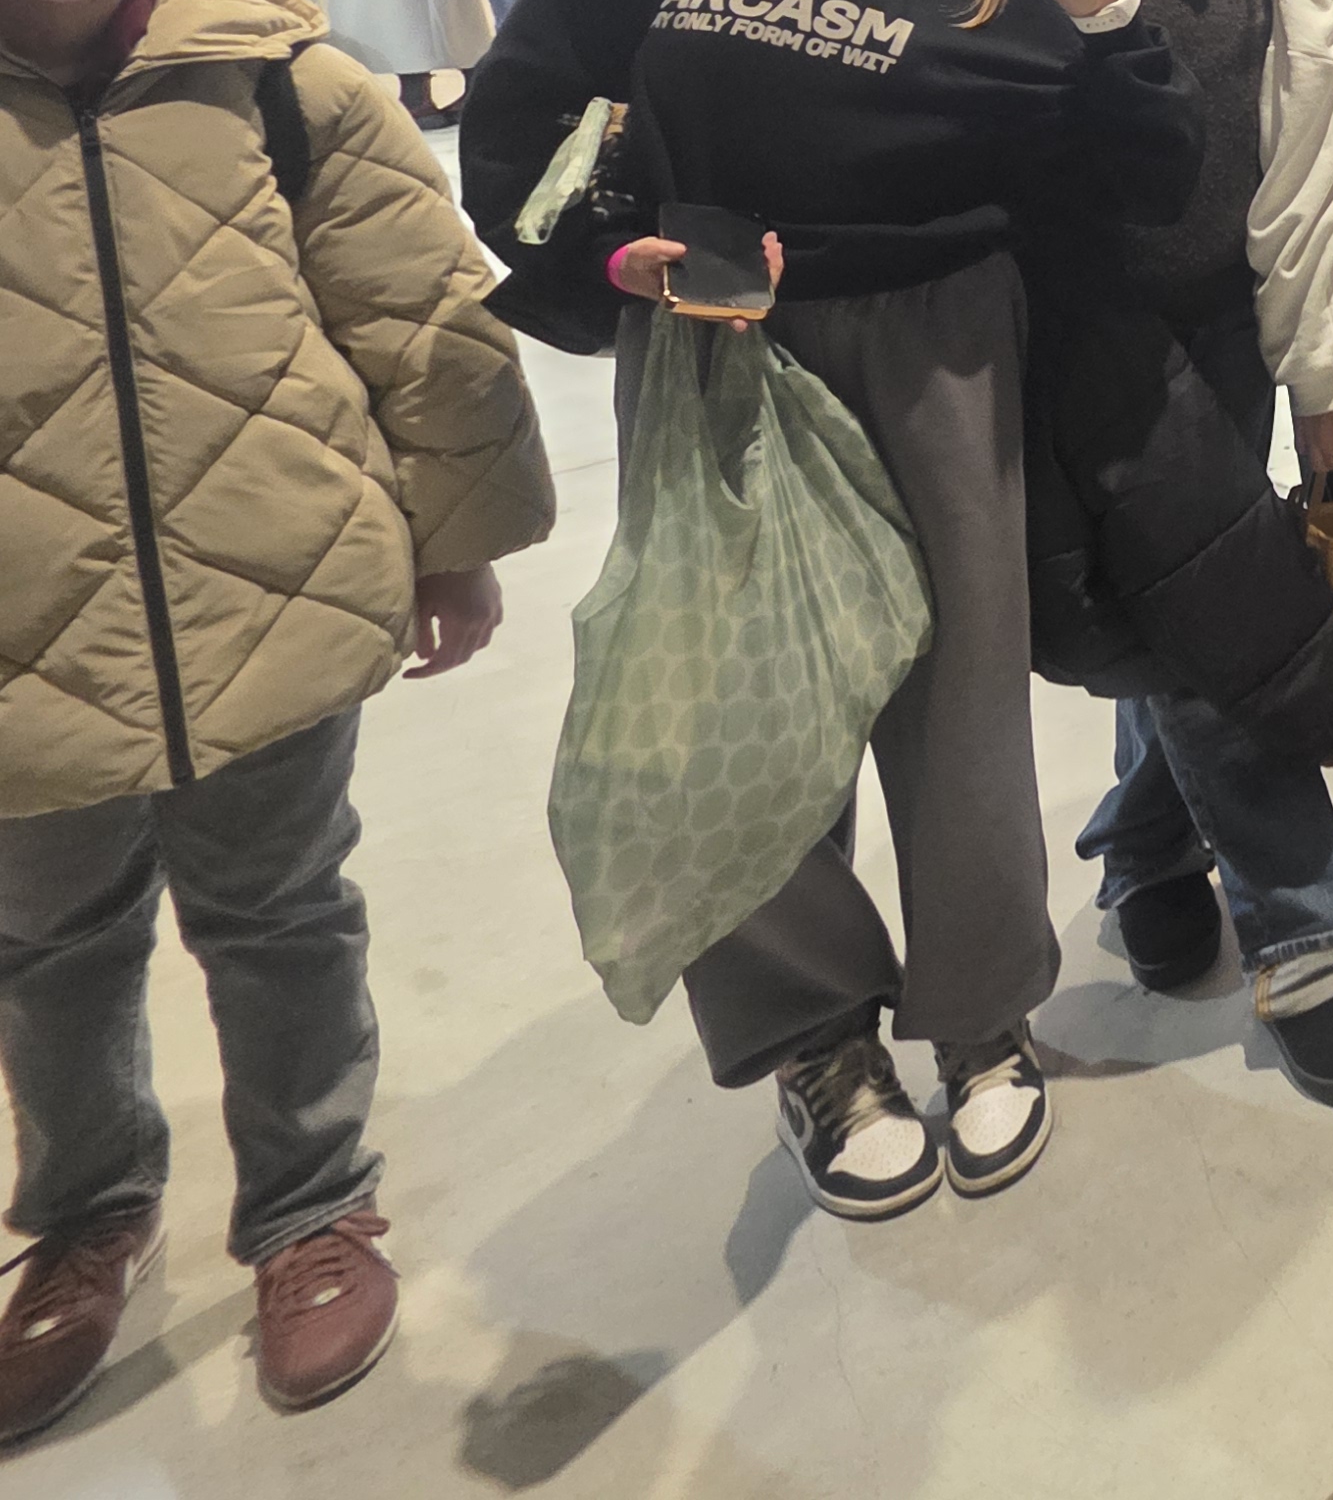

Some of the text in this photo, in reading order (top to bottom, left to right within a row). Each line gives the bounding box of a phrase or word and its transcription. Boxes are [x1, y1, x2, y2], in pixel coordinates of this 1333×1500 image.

[673, 11, 732, 33] ONLY
[730, 18, 805, 52] FORM
[805, 37, 842, 59] OF
[842, 45, 898, 74] WIT
